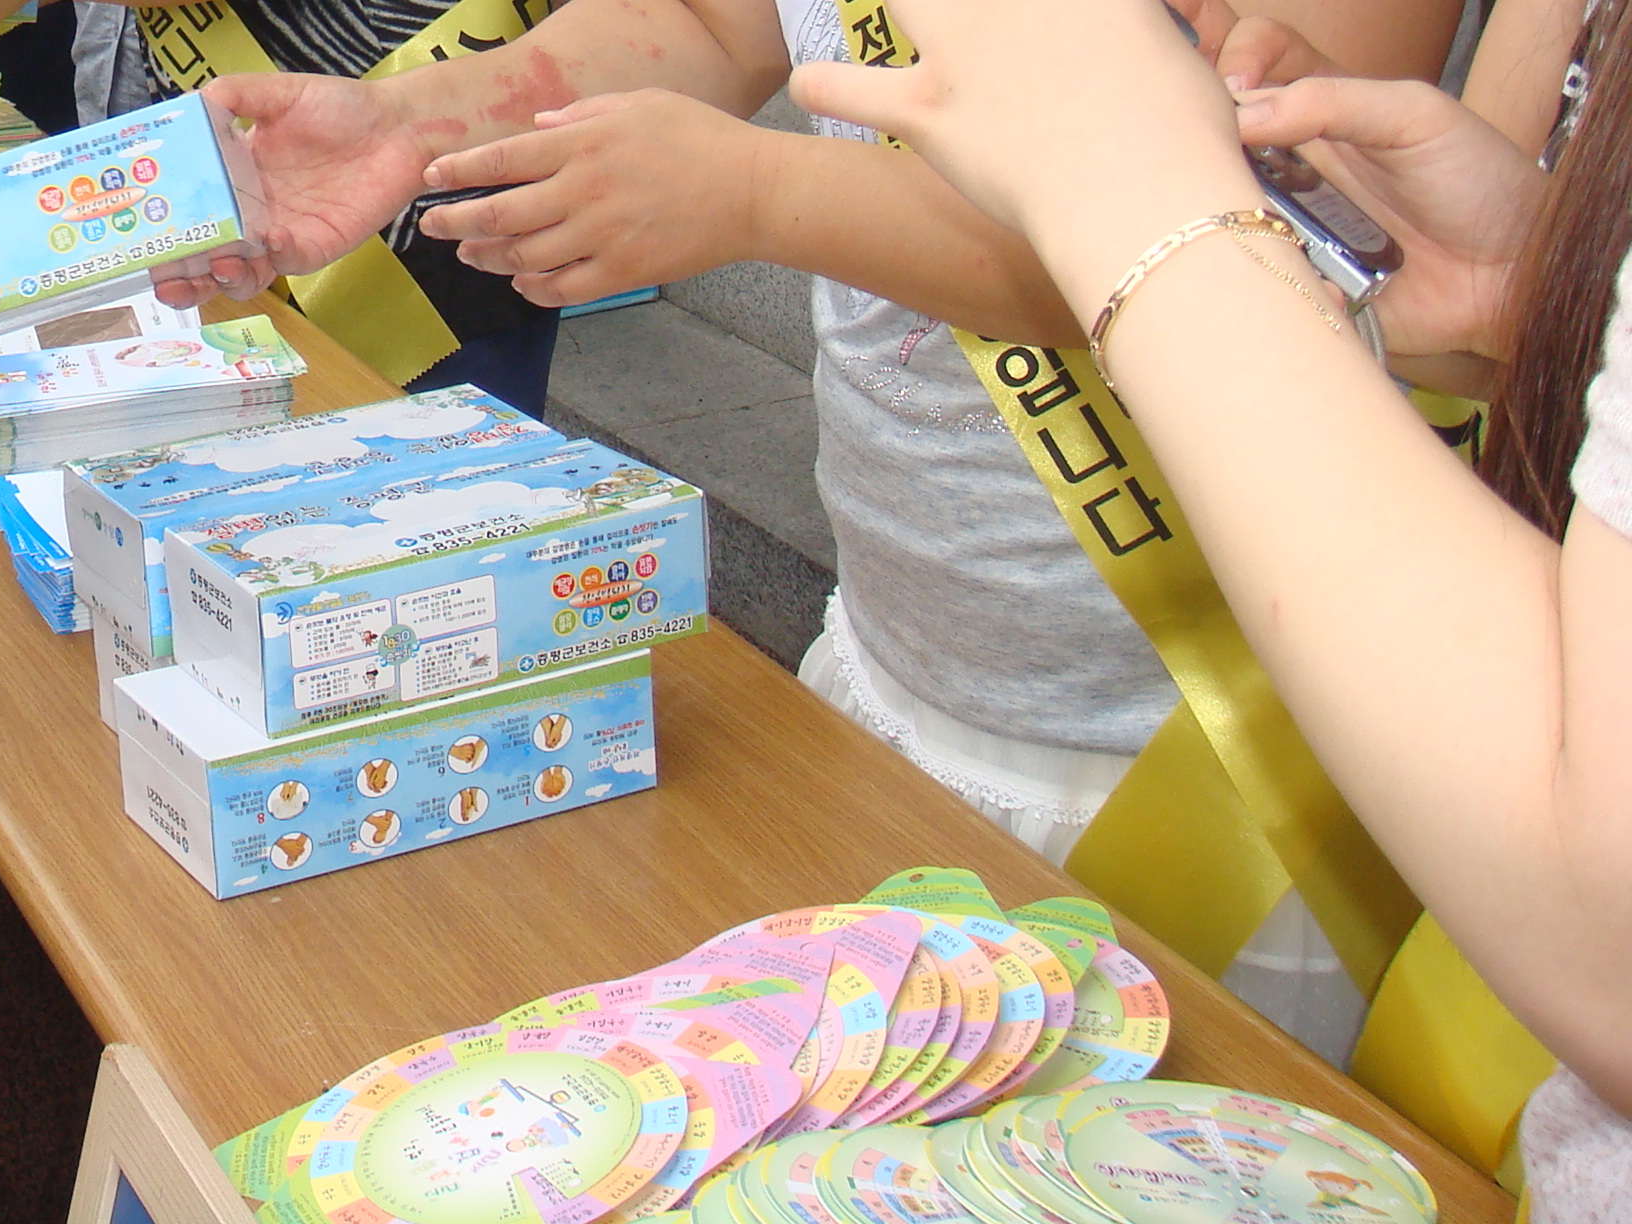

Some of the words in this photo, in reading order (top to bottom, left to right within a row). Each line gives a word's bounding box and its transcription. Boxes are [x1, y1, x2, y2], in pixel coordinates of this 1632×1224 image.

[39, 252, 125, 289] 증평군보건소
[145, 222, 219, 255] 835-4221
[988, 344, 1174, 556] 입니다
[418, 510, 527, 542] 증평군보건소
[433, 520, 532, 552] 835-4221
[198, 574, 233, 610] 증평군보건소
[198, 594, 233, 632] 835-4221
[537, 637, 613, 667] 증평군보건소
[630, 615, 694, 644] 835-4221
[438, 766, 446, 777] 6
[257, 812, 266, 824] 8
[438, 817, 447, 829] 2
[349, 841, 358, 852] 3
